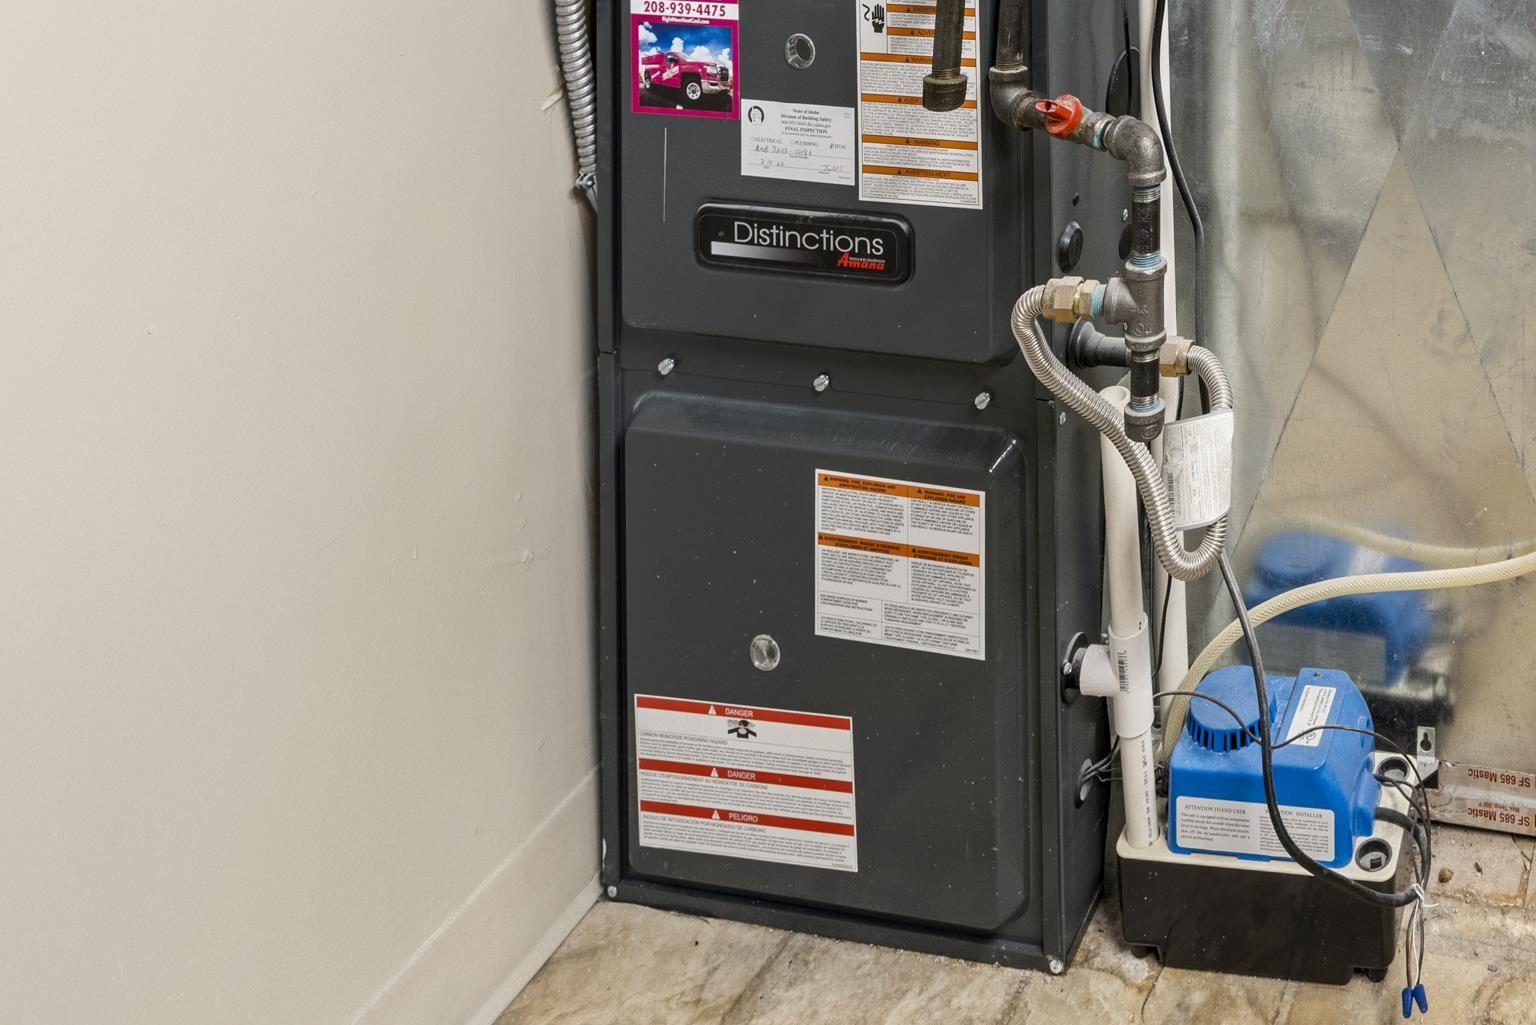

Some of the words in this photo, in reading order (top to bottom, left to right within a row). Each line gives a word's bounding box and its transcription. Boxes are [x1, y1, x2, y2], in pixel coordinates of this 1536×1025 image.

[644, 1, 726, 17] 208-939-4475
[734, 221, 884, 255] Distinctions
[837, 252, 886, 271] Amana
[725, 707, 754, 718] DANGER
[727, 770, 756, 780] DANGER
[1467, 767, 1498, 782] Mastic
[1499, 773, 1517, 785] 685
[1518, 777, 1531, 787] SF
[1185, 804, 1215, 812] ATTENTION
[728, 812, 758, 823] PELIGRO
[1467, 807, 1497, 821] Mastic
[1499, 813, 1517, 824] 685
[1518, 816, 1530, 826] SF
